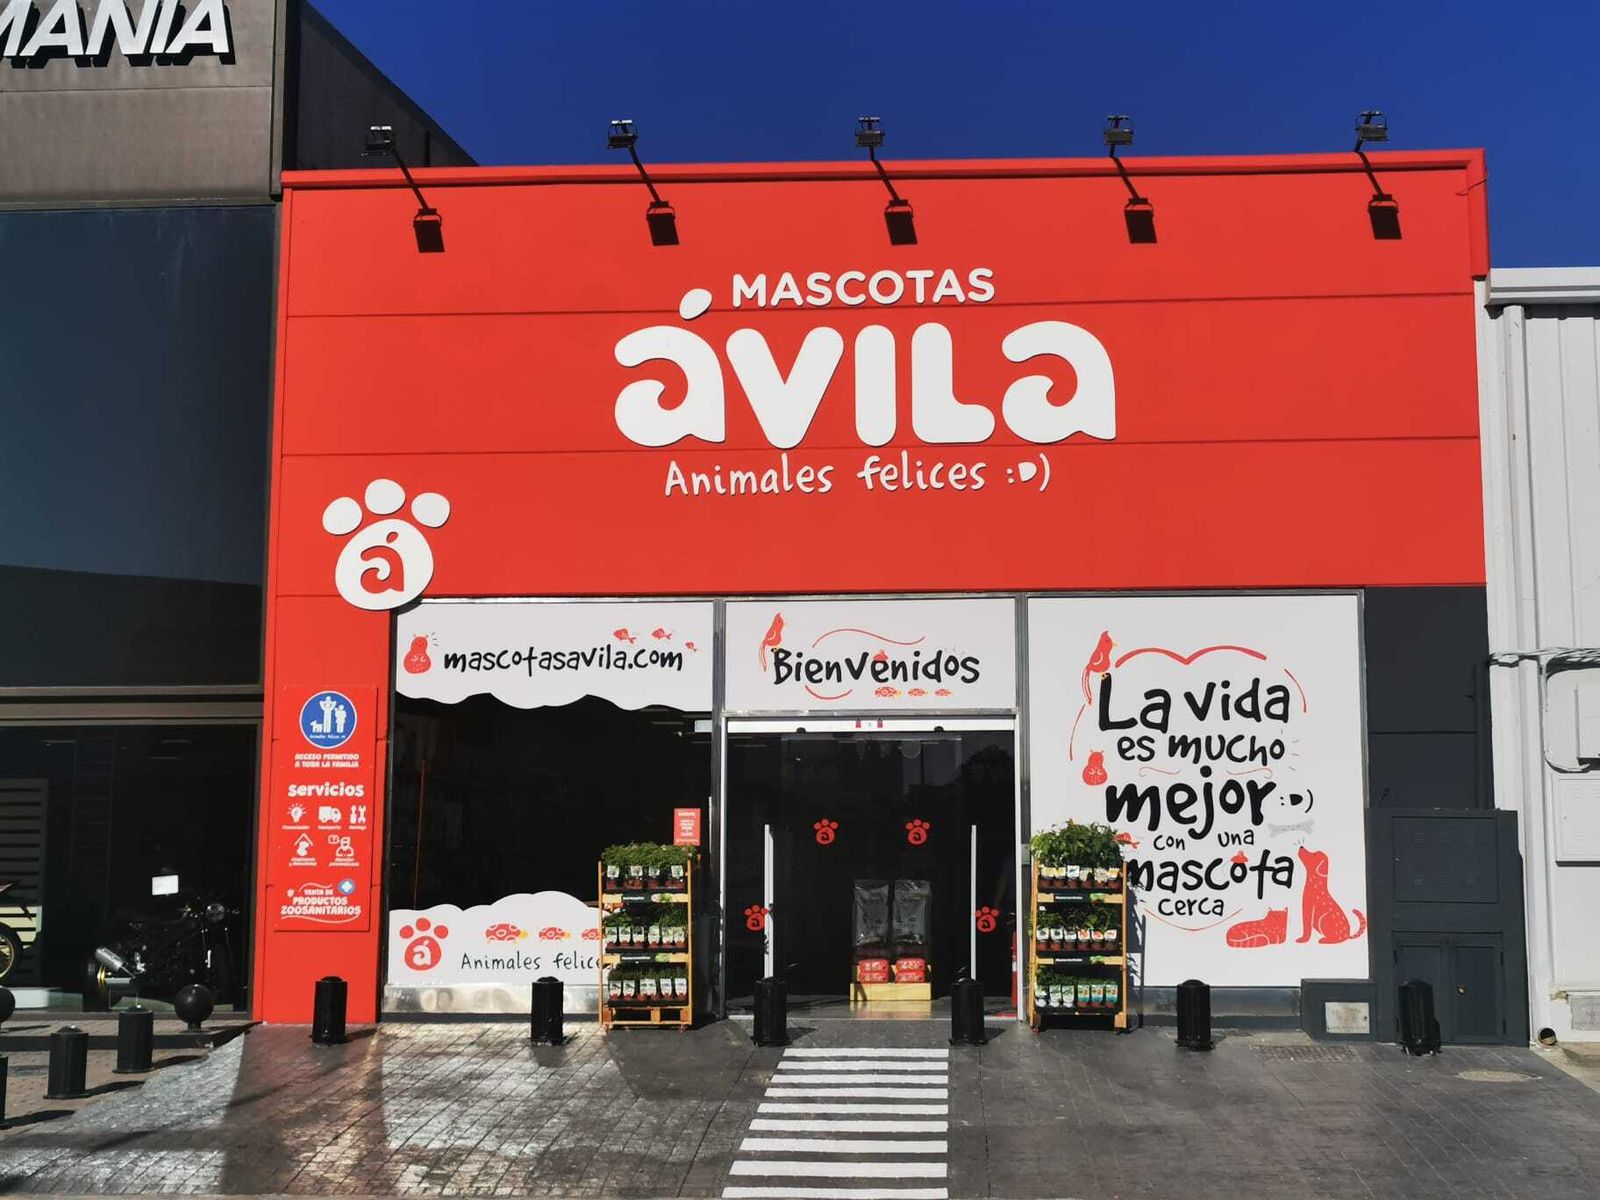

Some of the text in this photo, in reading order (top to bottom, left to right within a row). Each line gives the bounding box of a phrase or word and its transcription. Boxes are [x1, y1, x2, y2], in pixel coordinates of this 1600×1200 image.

[731, 268, 995, 307] MASCOTAS
[665, 453, 834, 496] Animales
[857, 450, 987, 492] felices
[444, 644, 683, 677] mascotasavila.com
[1098, 672, 1290, 734] La vida
[1117, 734, 1285, 766] es mucho
[288, 781, 365, 798] servicios
[1105, 765, 1277, 840] mejor
[1153, 829, 1255, 851] con una
[281, 905, 361, 915] ZOOSANITARIOS
[292, 896, 348, 905] PRODUCTOS
[1158, 897, 1224, 916] cerca
[461, 951, 541, 970] Animales
